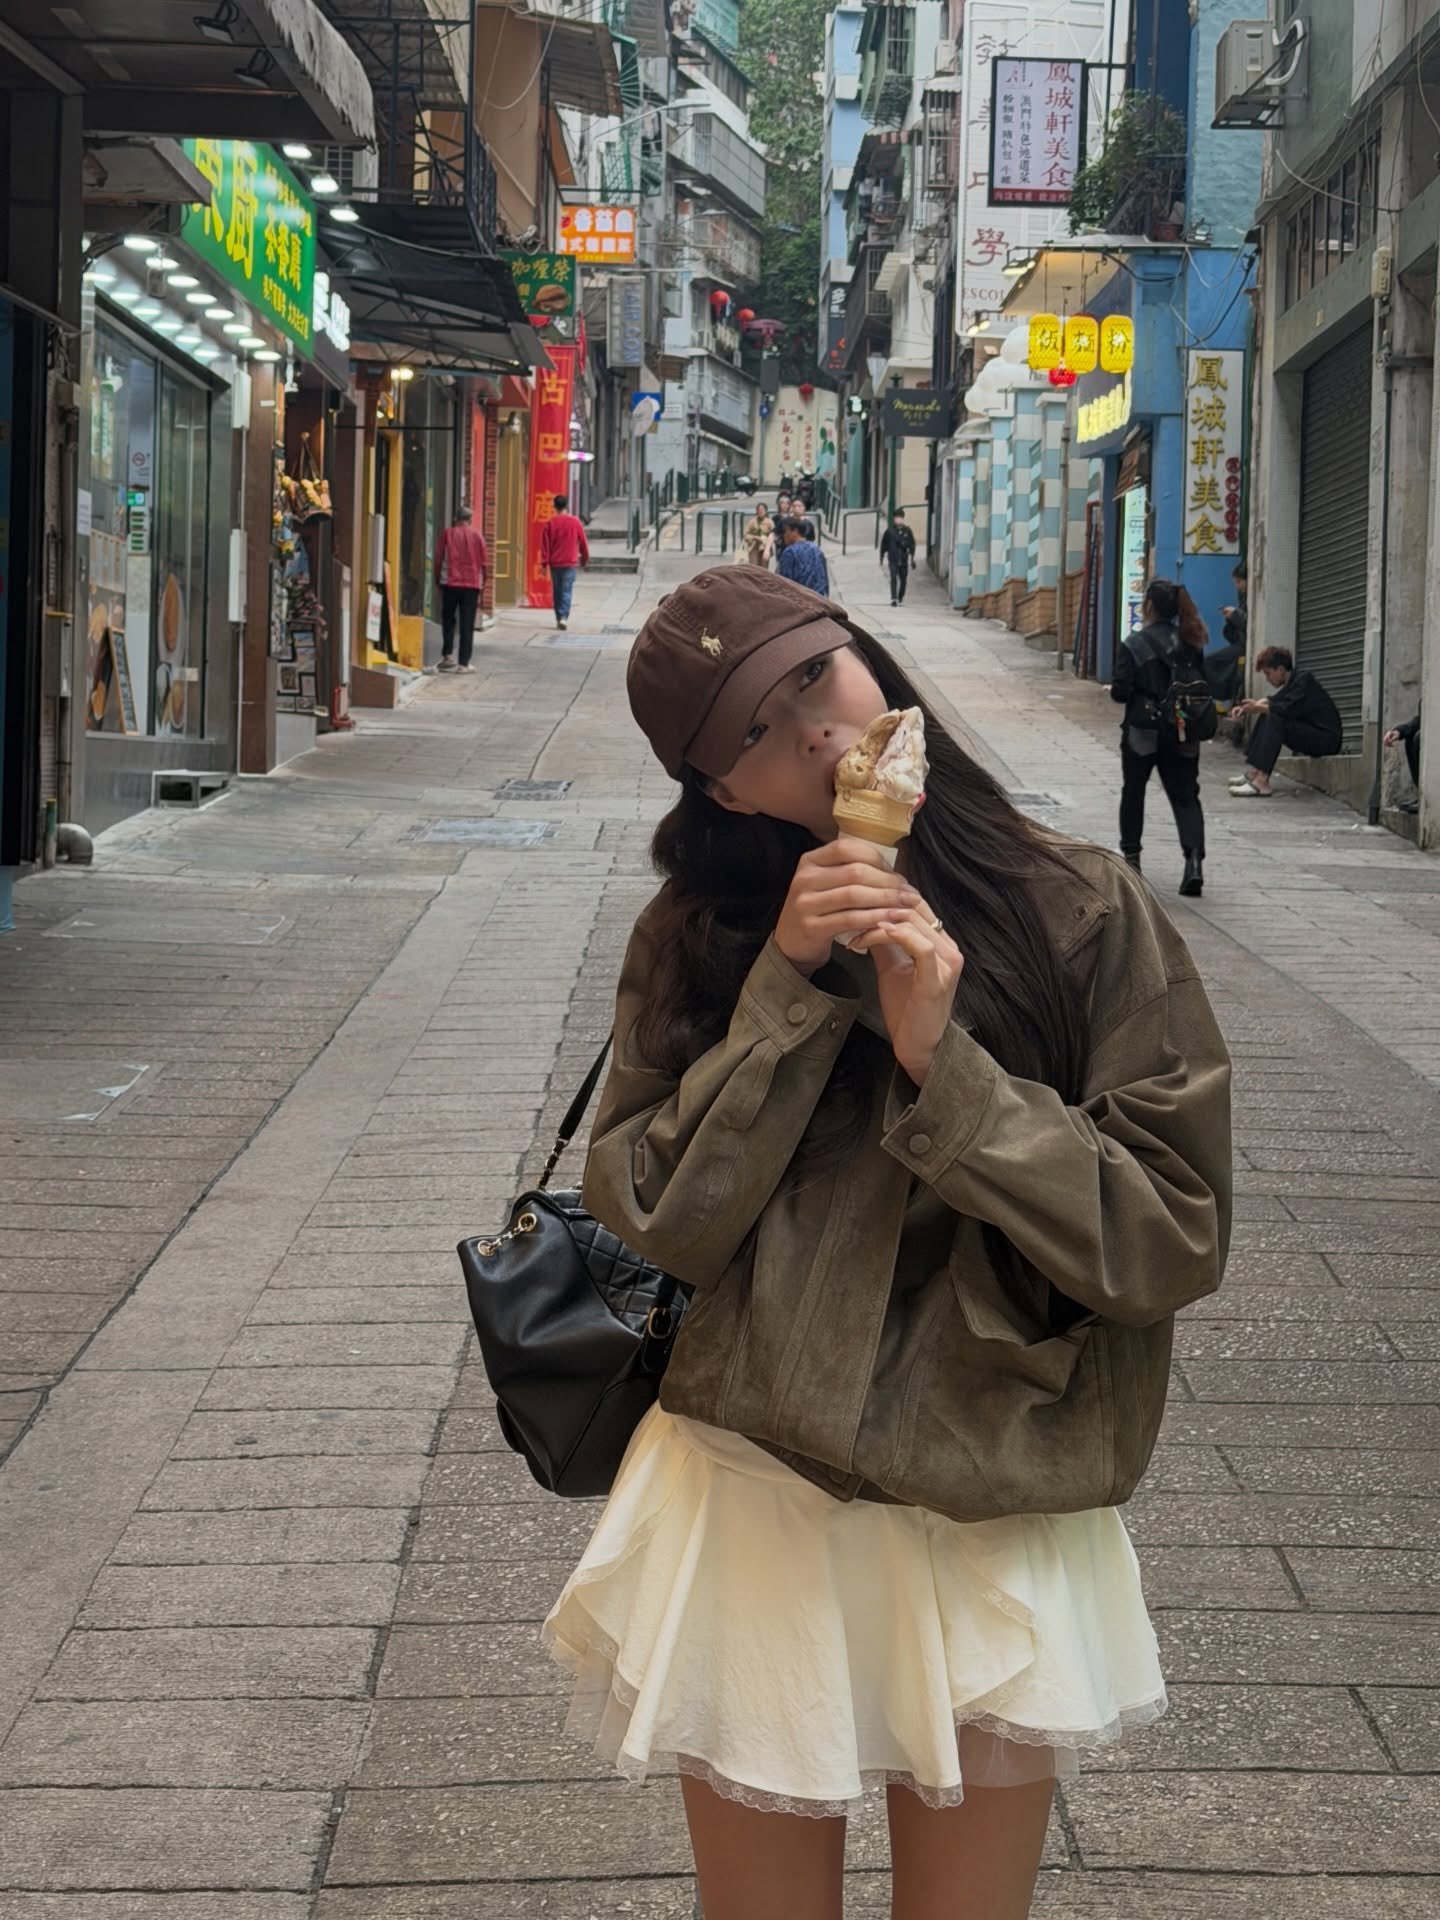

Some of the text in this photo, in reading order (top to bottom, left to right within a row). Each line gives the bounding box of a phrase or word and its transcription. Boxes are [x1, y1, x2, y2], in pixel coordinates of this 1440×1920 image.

[1184, 355, 1228, 553] 鳳城軒美食
